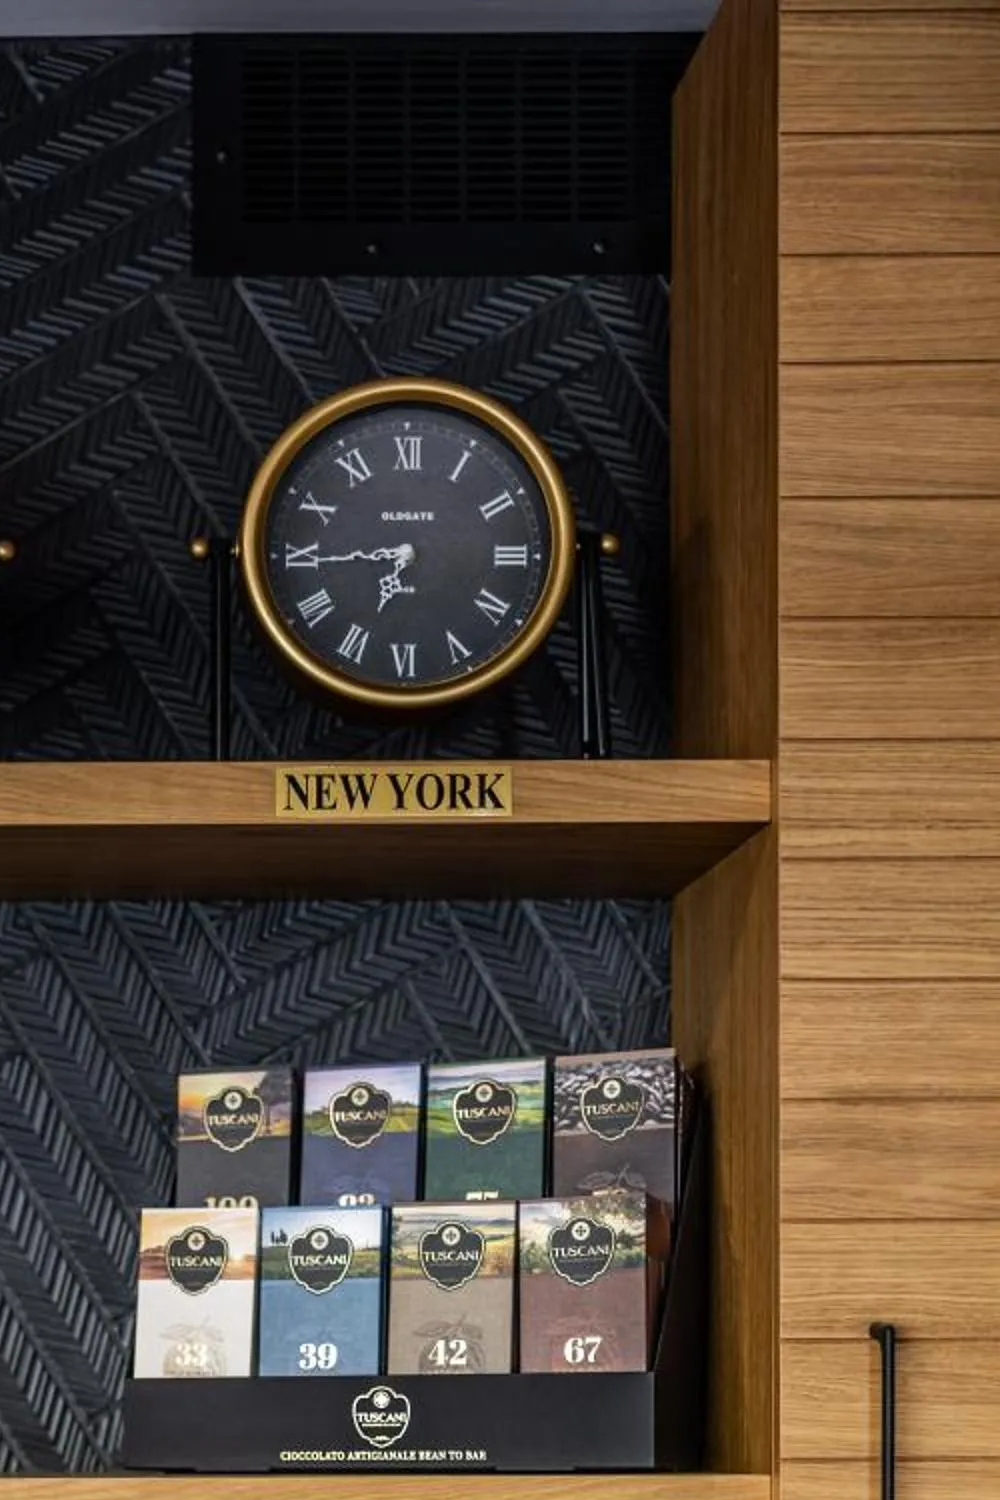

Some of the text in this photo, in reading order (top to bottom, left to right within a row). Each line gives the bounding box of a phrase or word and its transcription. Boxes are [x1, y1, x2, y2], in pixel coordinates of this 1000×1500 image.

[394, 437, 422, 470] XII
[449, 451, 471, 481] I
[335, 449, 372, 488] XI
[300, 492, 338, 526] X
[381, 511, 435, 521] OLDGATE
[479, 491, 514, 520] II
[494, 544, 527, 567] III
[297, 589, 335, 628] VIII
[474, 589, 511, 626] IV
[338, 624, 369, 664] VII
[447, 631, 472, 664] V
[391, 644, 416, 677] VI
[283, 773, 506, 811] NEW YORK
[169, 1256, 222, 1268] TUSCANI
[291, 1254, 348, 1266] TUSCANI
[422, 1251, 479, 1263] TUSCANI
[553, 1245, 609, 1259] TUSCANI
[175, 1343, 209, 1367] 33
[299, 1342, 338, 1370] 39
[428, 1339, 468, 1366] 42
[563, 1336, 603, 1364] 67
[280, 1451, 487, 1461] CIOCCOLATO ARTIGIANALE BEAN TO BAR
